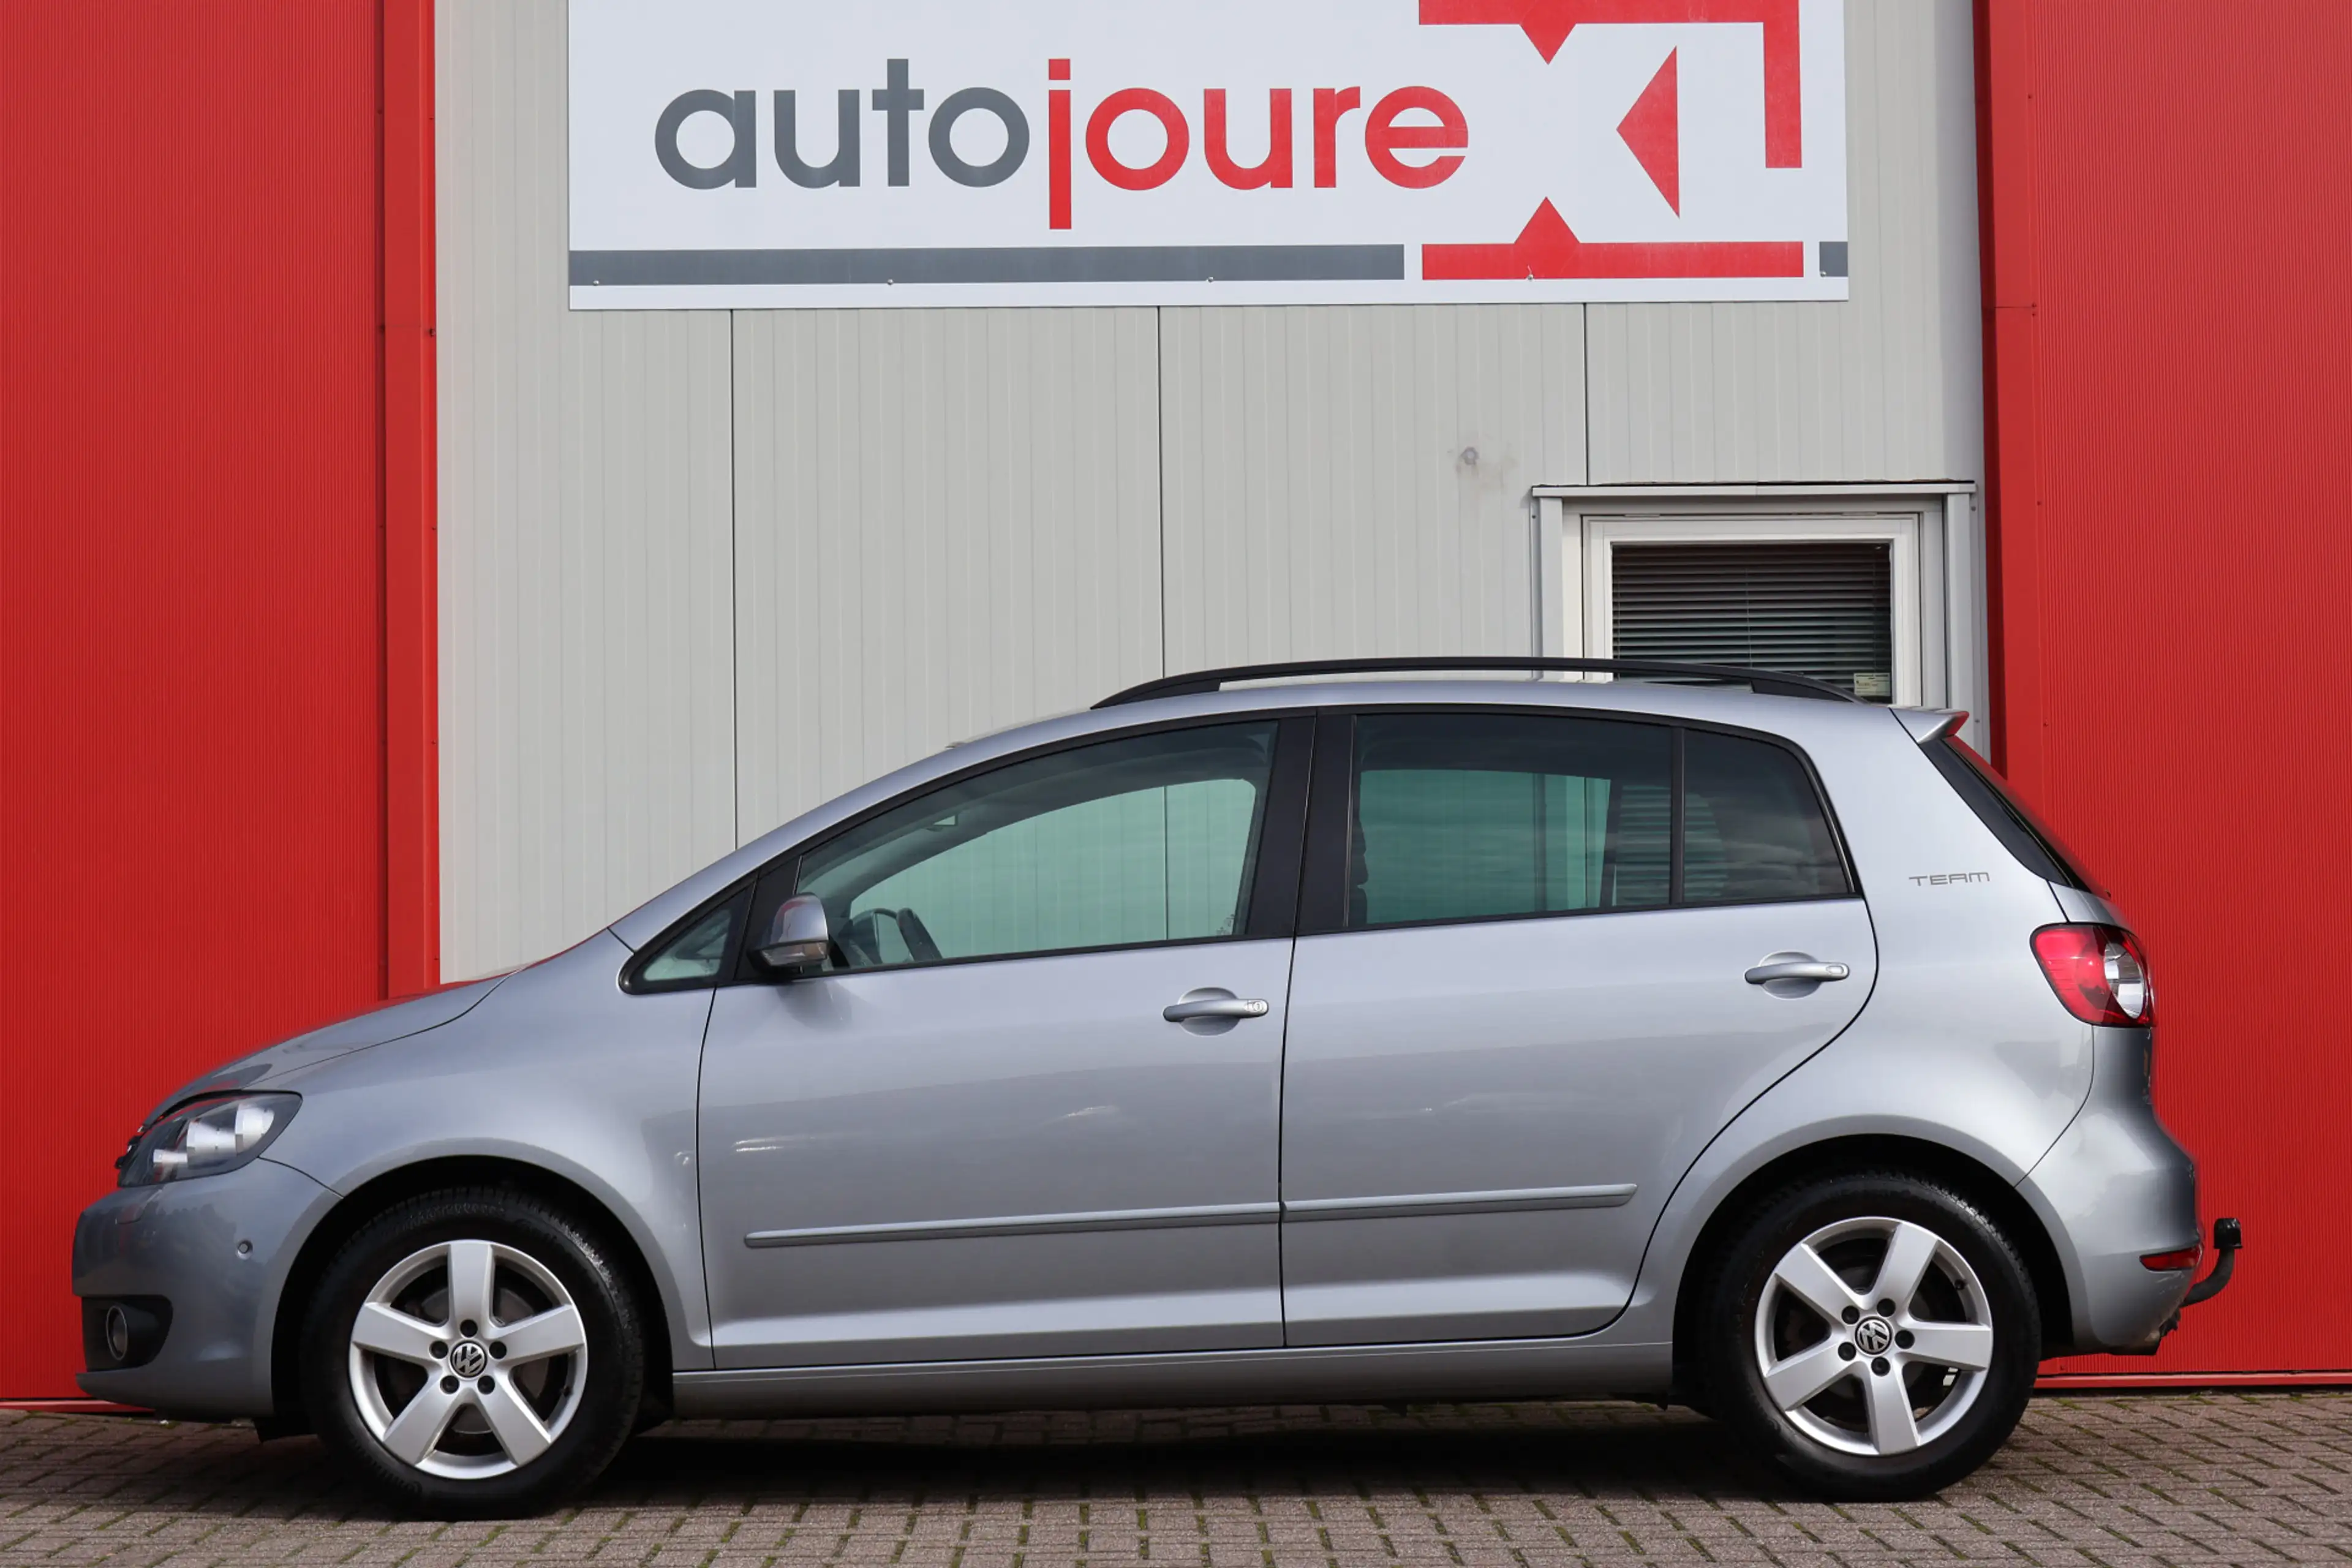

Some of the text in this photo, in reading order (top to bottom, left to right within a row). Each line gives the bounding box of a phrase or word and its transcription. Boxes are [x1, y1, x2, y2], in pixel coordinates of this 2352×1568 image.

[655, 59, 1469, 230] autojoure
[1909, 872, 1990, 886] TEAM
[451, 1341, 486, 1376] VW
